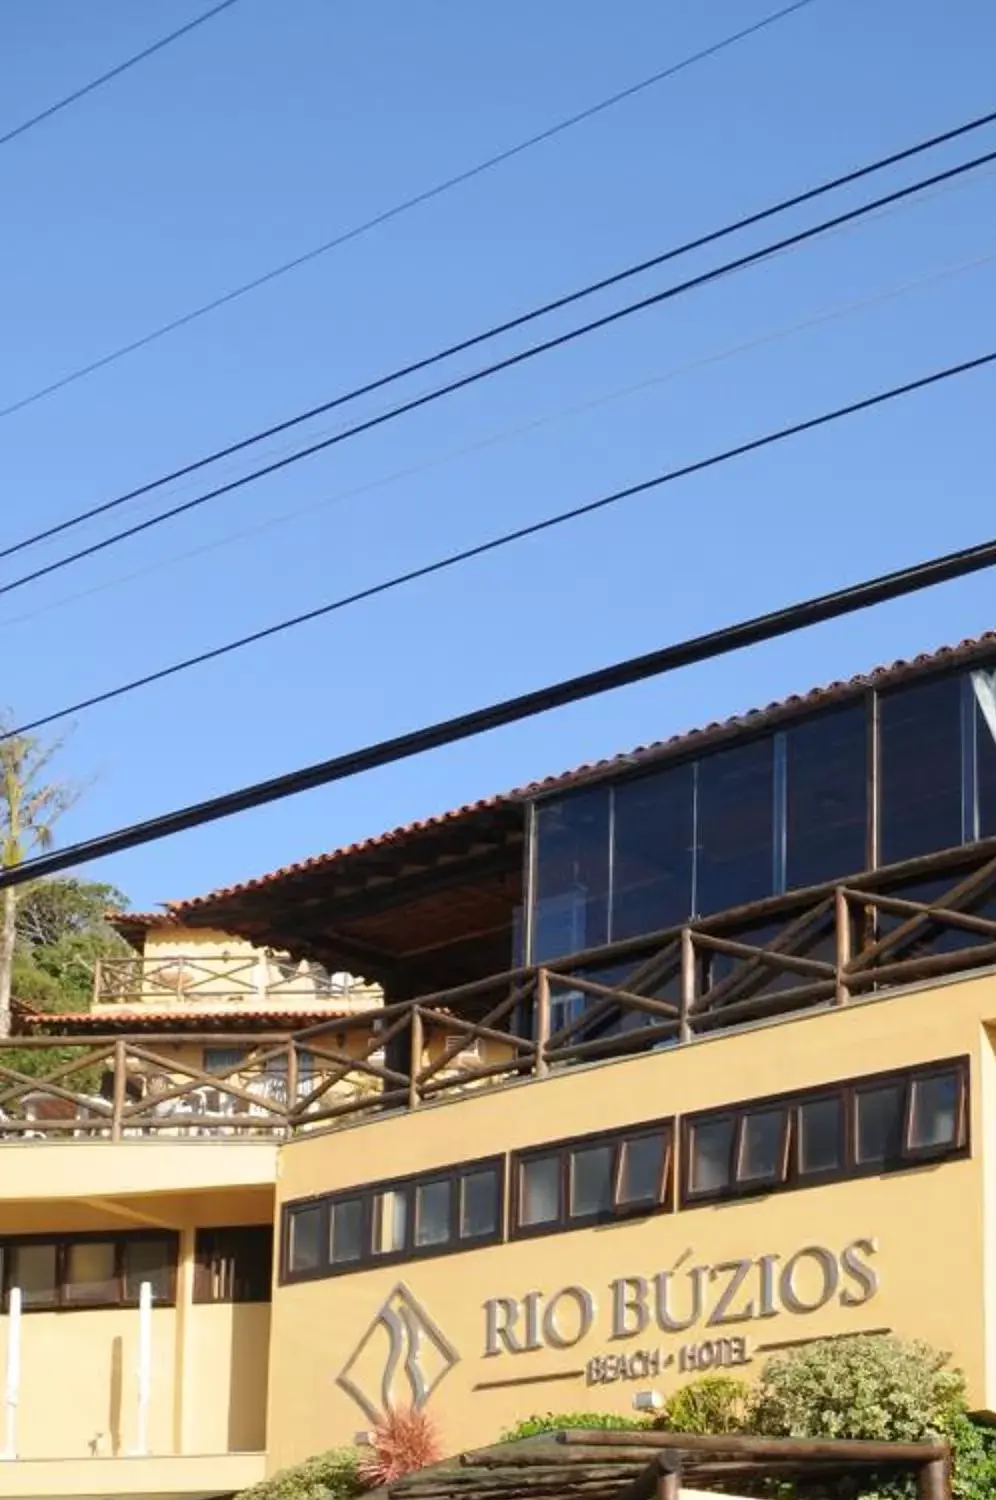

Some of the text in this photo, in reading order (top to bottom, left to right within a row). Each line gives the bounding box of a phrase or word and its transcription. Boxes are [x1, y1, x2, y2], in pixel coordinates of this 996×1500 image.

[482, 1237, 879, 1358] RIO BÚZIOS
[586, 1349, 659, 1386] BEACH
[679, 1336, 752, 1372] HOTEL
